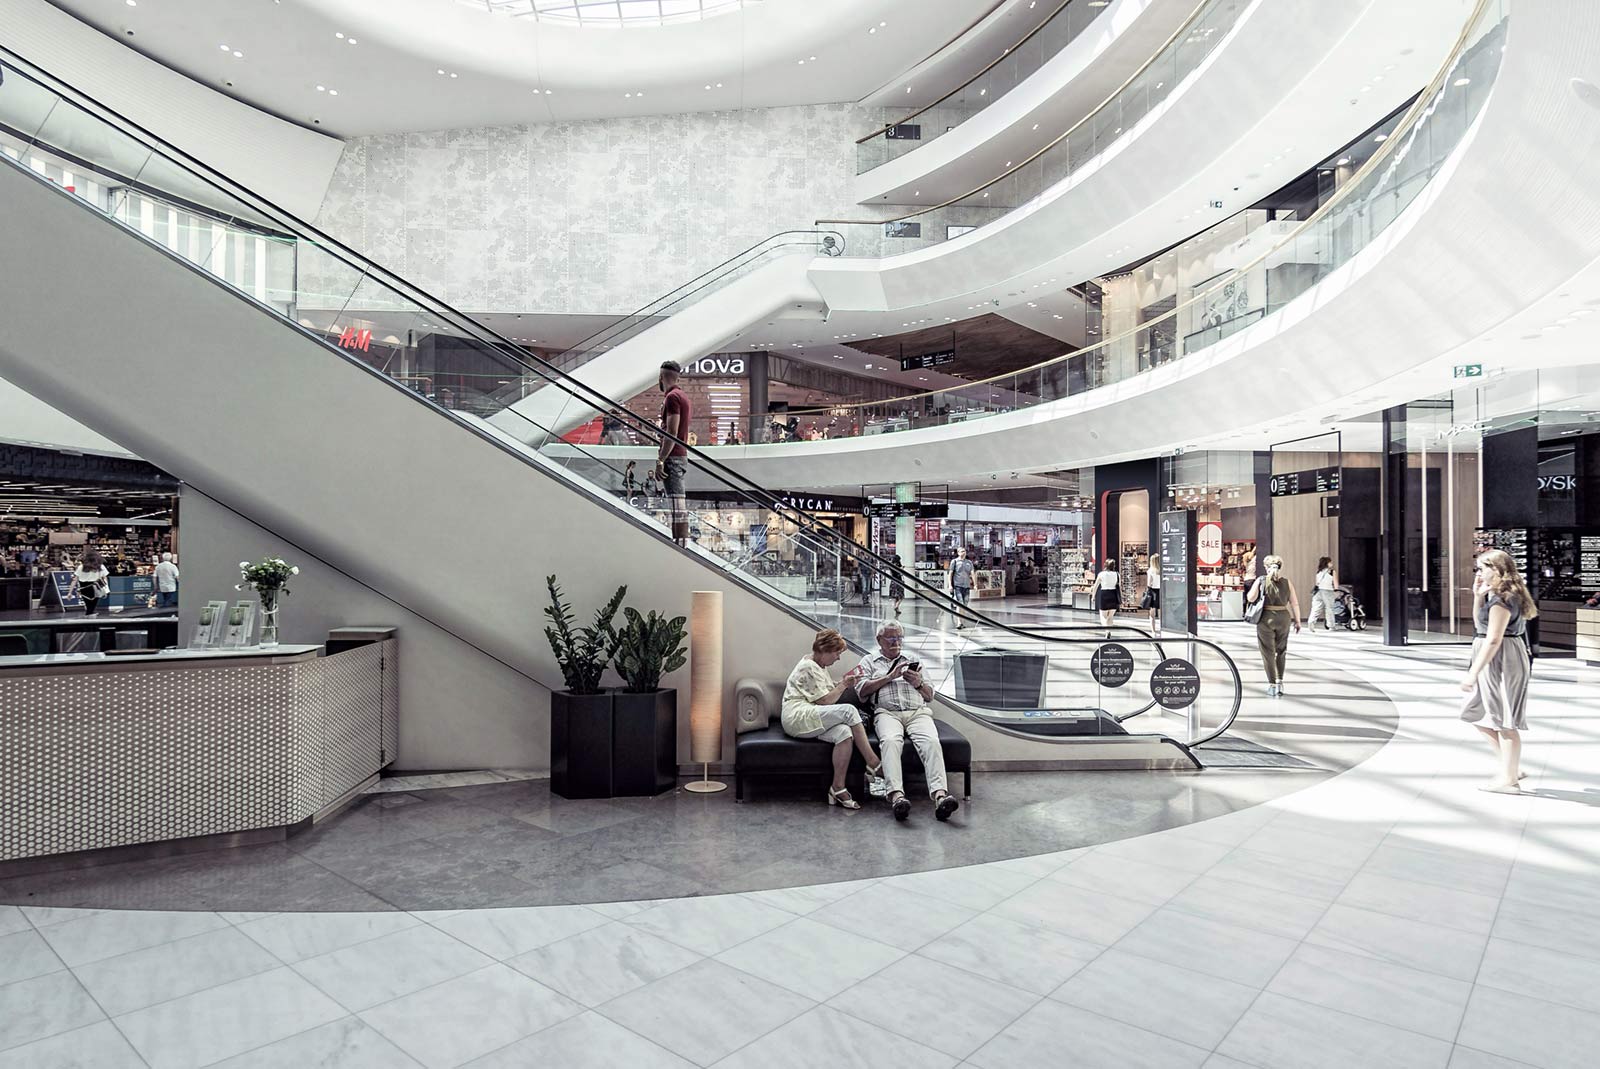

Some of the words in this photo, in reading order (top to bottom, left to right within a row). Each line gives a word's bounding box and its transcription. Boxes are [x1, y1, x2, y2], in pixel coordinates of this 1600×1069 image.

[338, 326, 372, 353] H&M
[679, 358, 745, 374] nova
[1270, 478, 1278, 493] 0
[863, 506, 870, 517] 0
[1201, 540, 1220, 549] SALE
